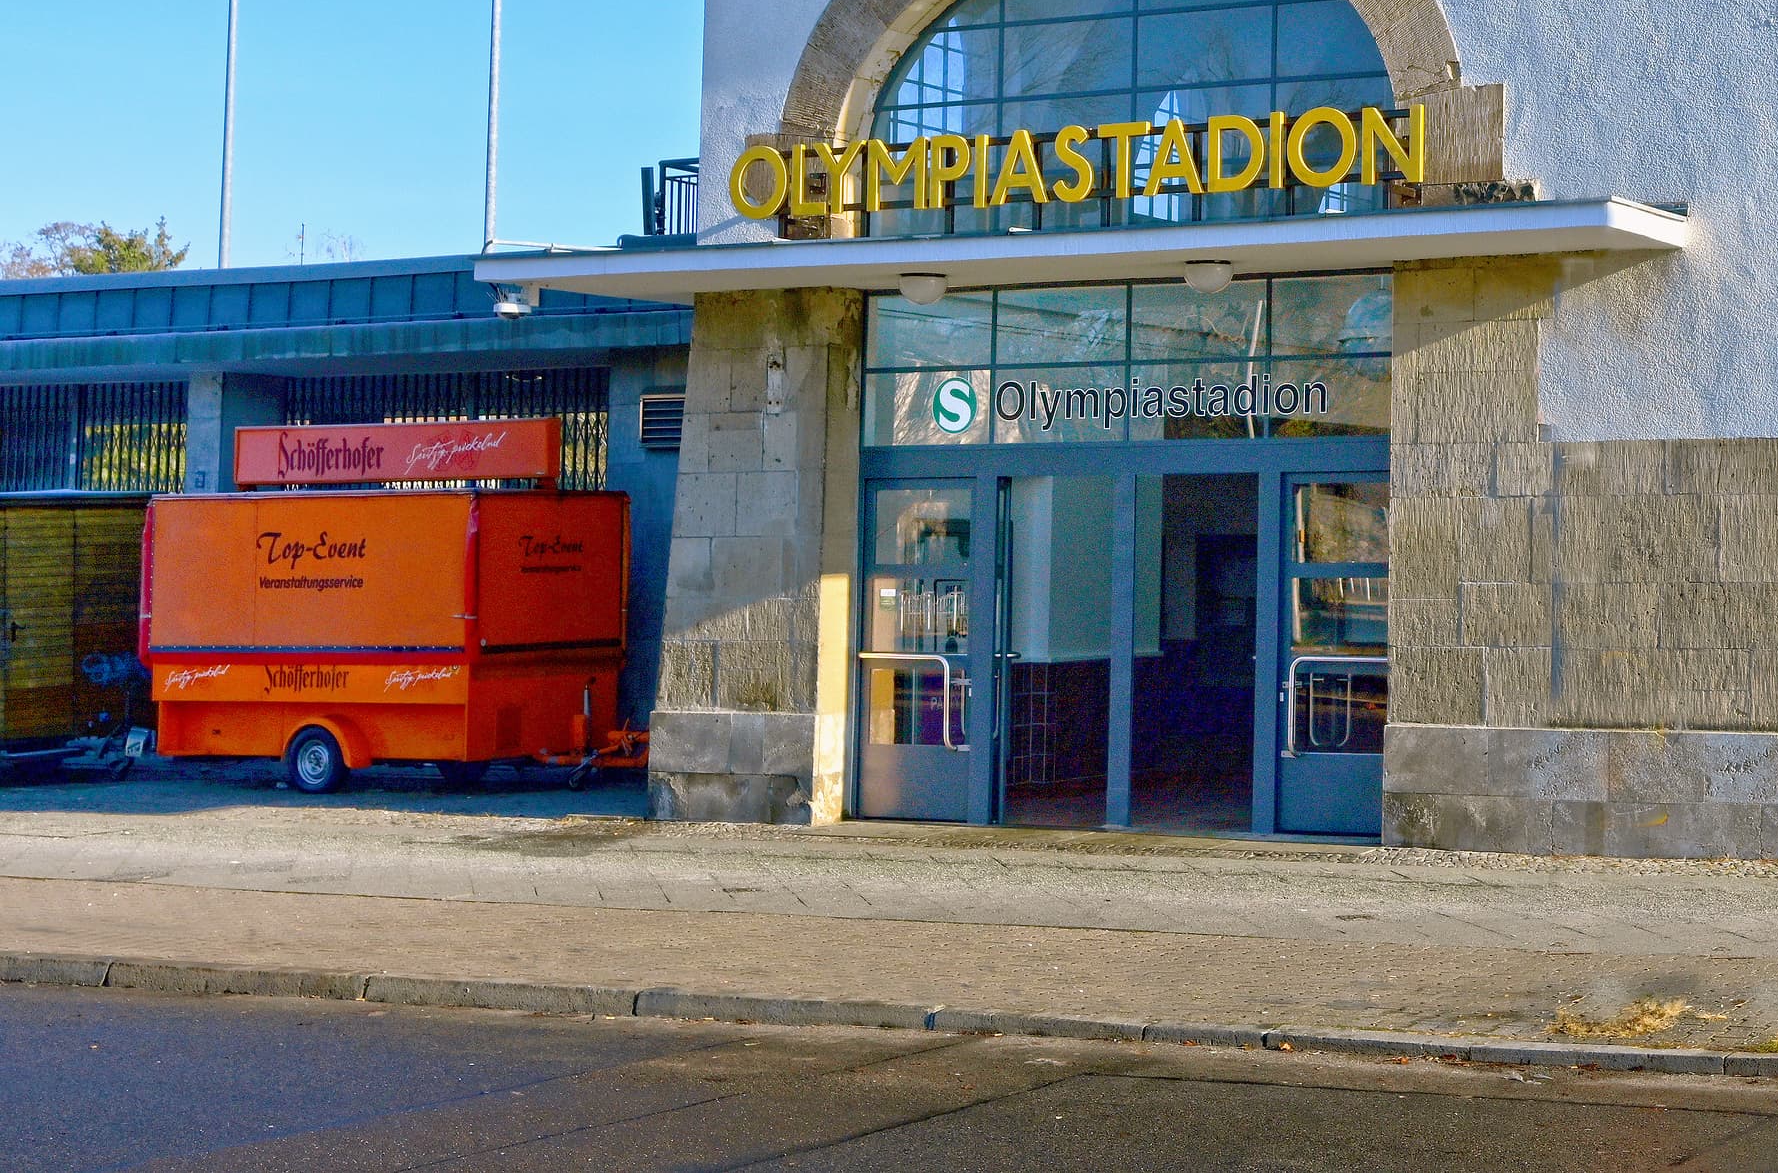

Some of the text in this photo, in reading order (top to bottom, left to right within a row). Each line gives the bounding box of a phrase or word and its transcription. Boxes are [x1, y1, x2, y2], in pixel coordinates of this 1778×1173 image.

[729, 103, 1425, 219] OLYMPIASTADION
[936, 373, 1329, 432] S Olympiastadion
[278, 431, 384, 479] Schöfferhofer
[256, 531, 366, 569] Top-Event
[259, 575, 364, 592] Veranstaltungsservice
